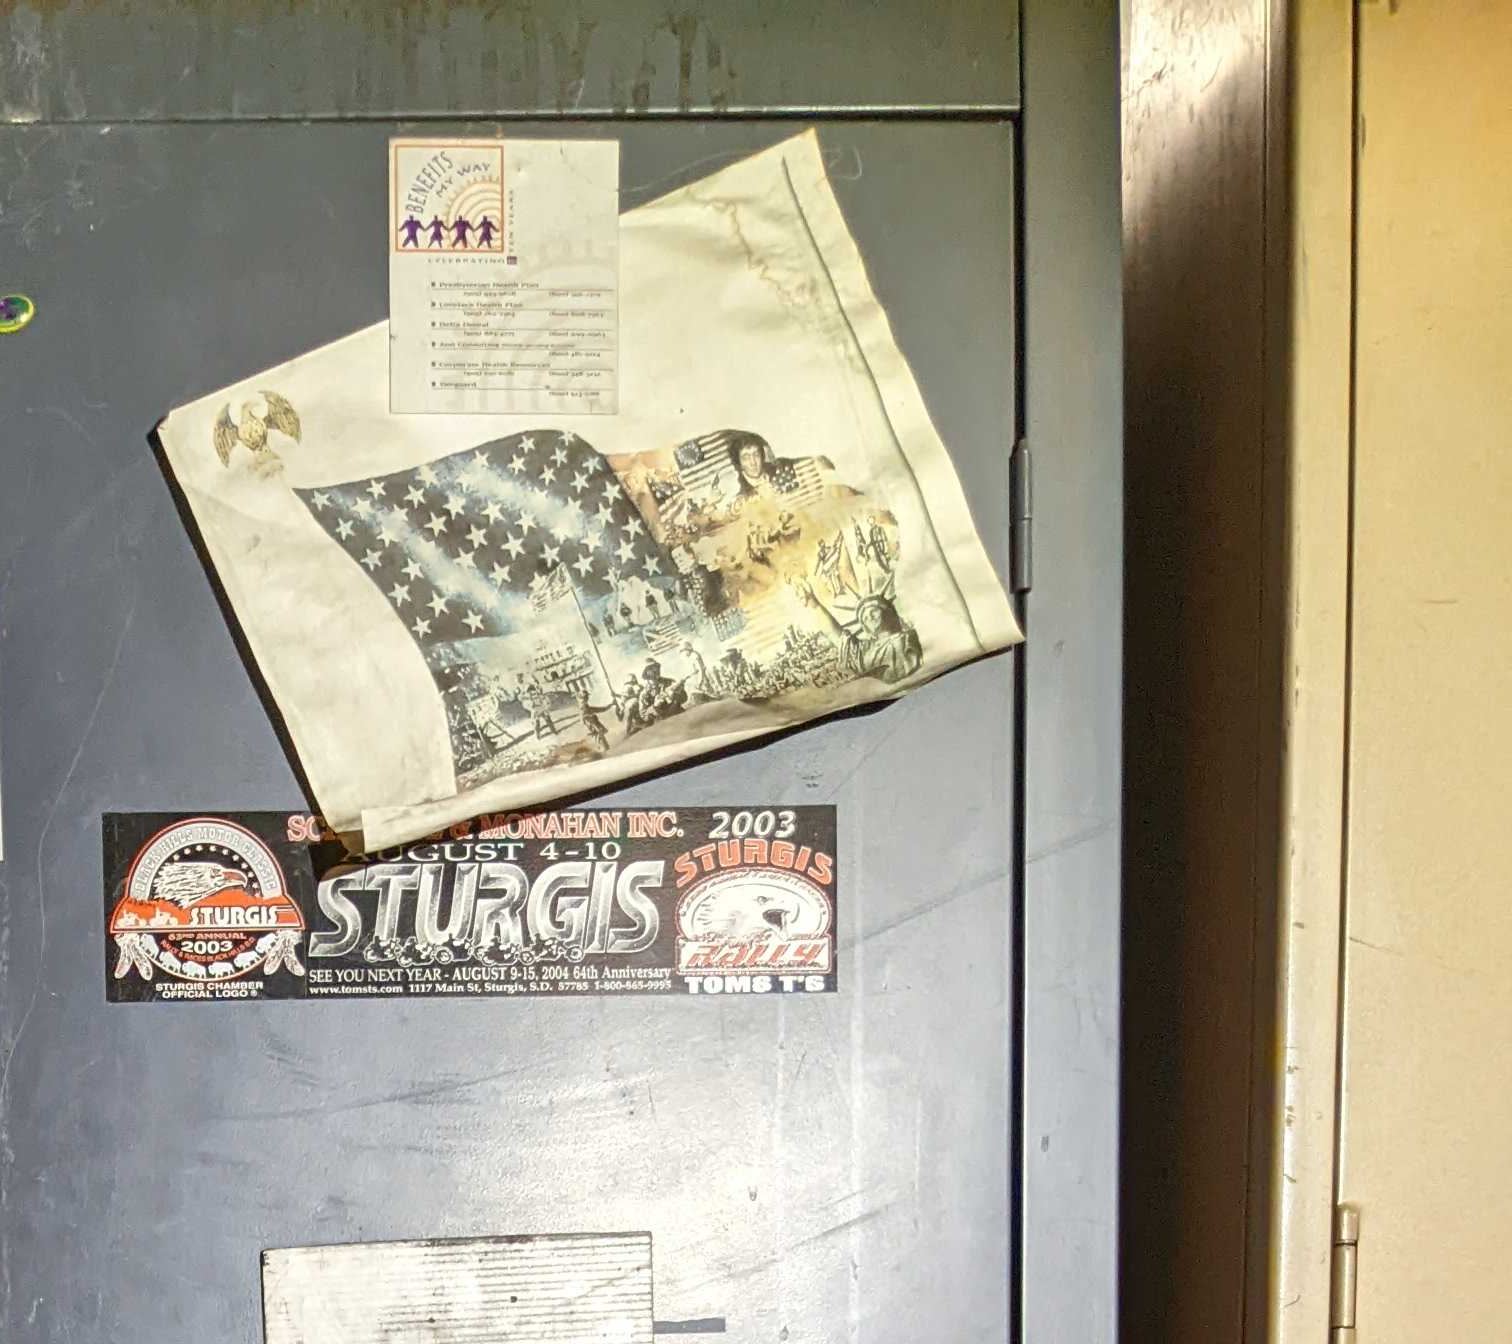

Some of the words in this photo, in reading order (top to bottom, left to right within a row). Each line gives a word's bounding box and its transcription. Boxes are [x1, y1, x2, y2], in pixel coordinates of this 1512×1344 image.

[405, 151, 454, 214] BENEFITS
[435, 176, 454, 198] MY
[456, 162, 491, 177] WAY
[478, 812, 622, 840] MONAHAN
[626, 810, 685, 840] INC.
[708, 810, 797, 839] 2003
[674, 838, 833, 889] STURGIS
[189, 905, 279, 926] STURGIS
[308, 860, 666, 959] STURGIS
[181, 940, 234, 955] 2003
[686, 940, 827, 968] RALLY
[309, 969, 333, 983] SEE
[335, 968, 365, 982] YOU
[367, 968, 403, 982] NEXT
[405, 967, 442, 982] YEAR
[452, 966, 508, 981] AUGUST
[541, 966, 569, 980] 2004
[573, 964, 599, 980] 64th
[601, 965, 672, 981] Anniversary
[684, 975, 772, 994] TOMS
[779, 974, 825, 993] T'S
[155, 982, 205, 992] STURGIS
[206, 981, 264, 991] CHAMBER
[161, 990, 214, 999] OFFICIAL
[215, 989, 249, 998] LOGO
[309, 984, 403, 995] www.tomsts.com
[408, 983, 433, 993] 1117
[435, 983, 465, 993] Main
[467, 983, 482, 994] St,
[484, 982, 527, 994] Sturgis,
[529, 982, 553, 992] S.D.
